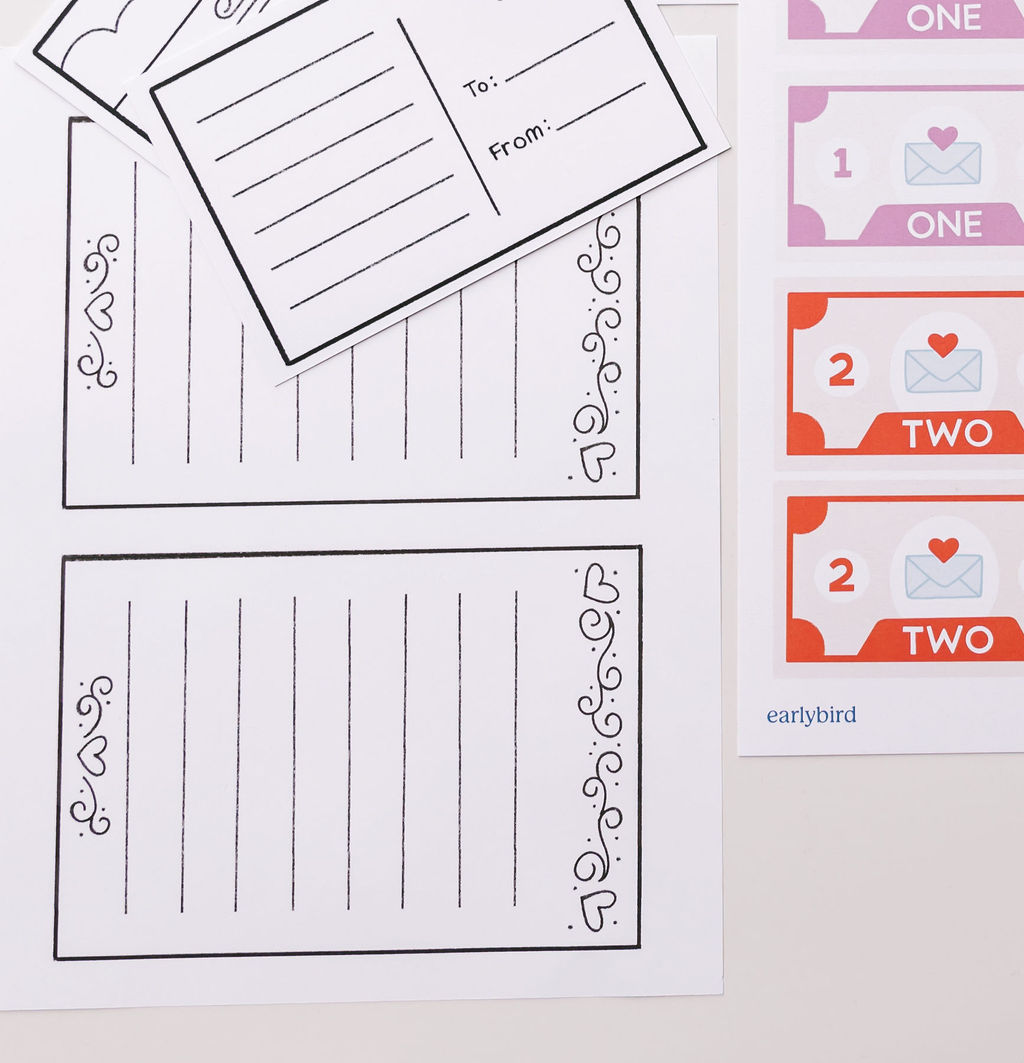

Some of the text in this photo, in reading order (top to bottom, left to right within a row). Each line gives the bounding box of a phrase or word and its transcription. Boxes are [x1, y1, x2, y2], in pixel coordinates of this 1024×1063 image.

[907, 3, 982, 32] ONE
[463, 75, 498, 98] To:
[488, 118, 552, 161] From:
[833, 148, 852, 178] 1
[907, 210, 982, 239] ONE
[829, 353, 855, 386] 2
[902, 418, 993, 448] TWO
[829, 557, 855, 592] 2
[902, 625, 994, 655] TWO
[766, 705, 857, 728] earlybird
